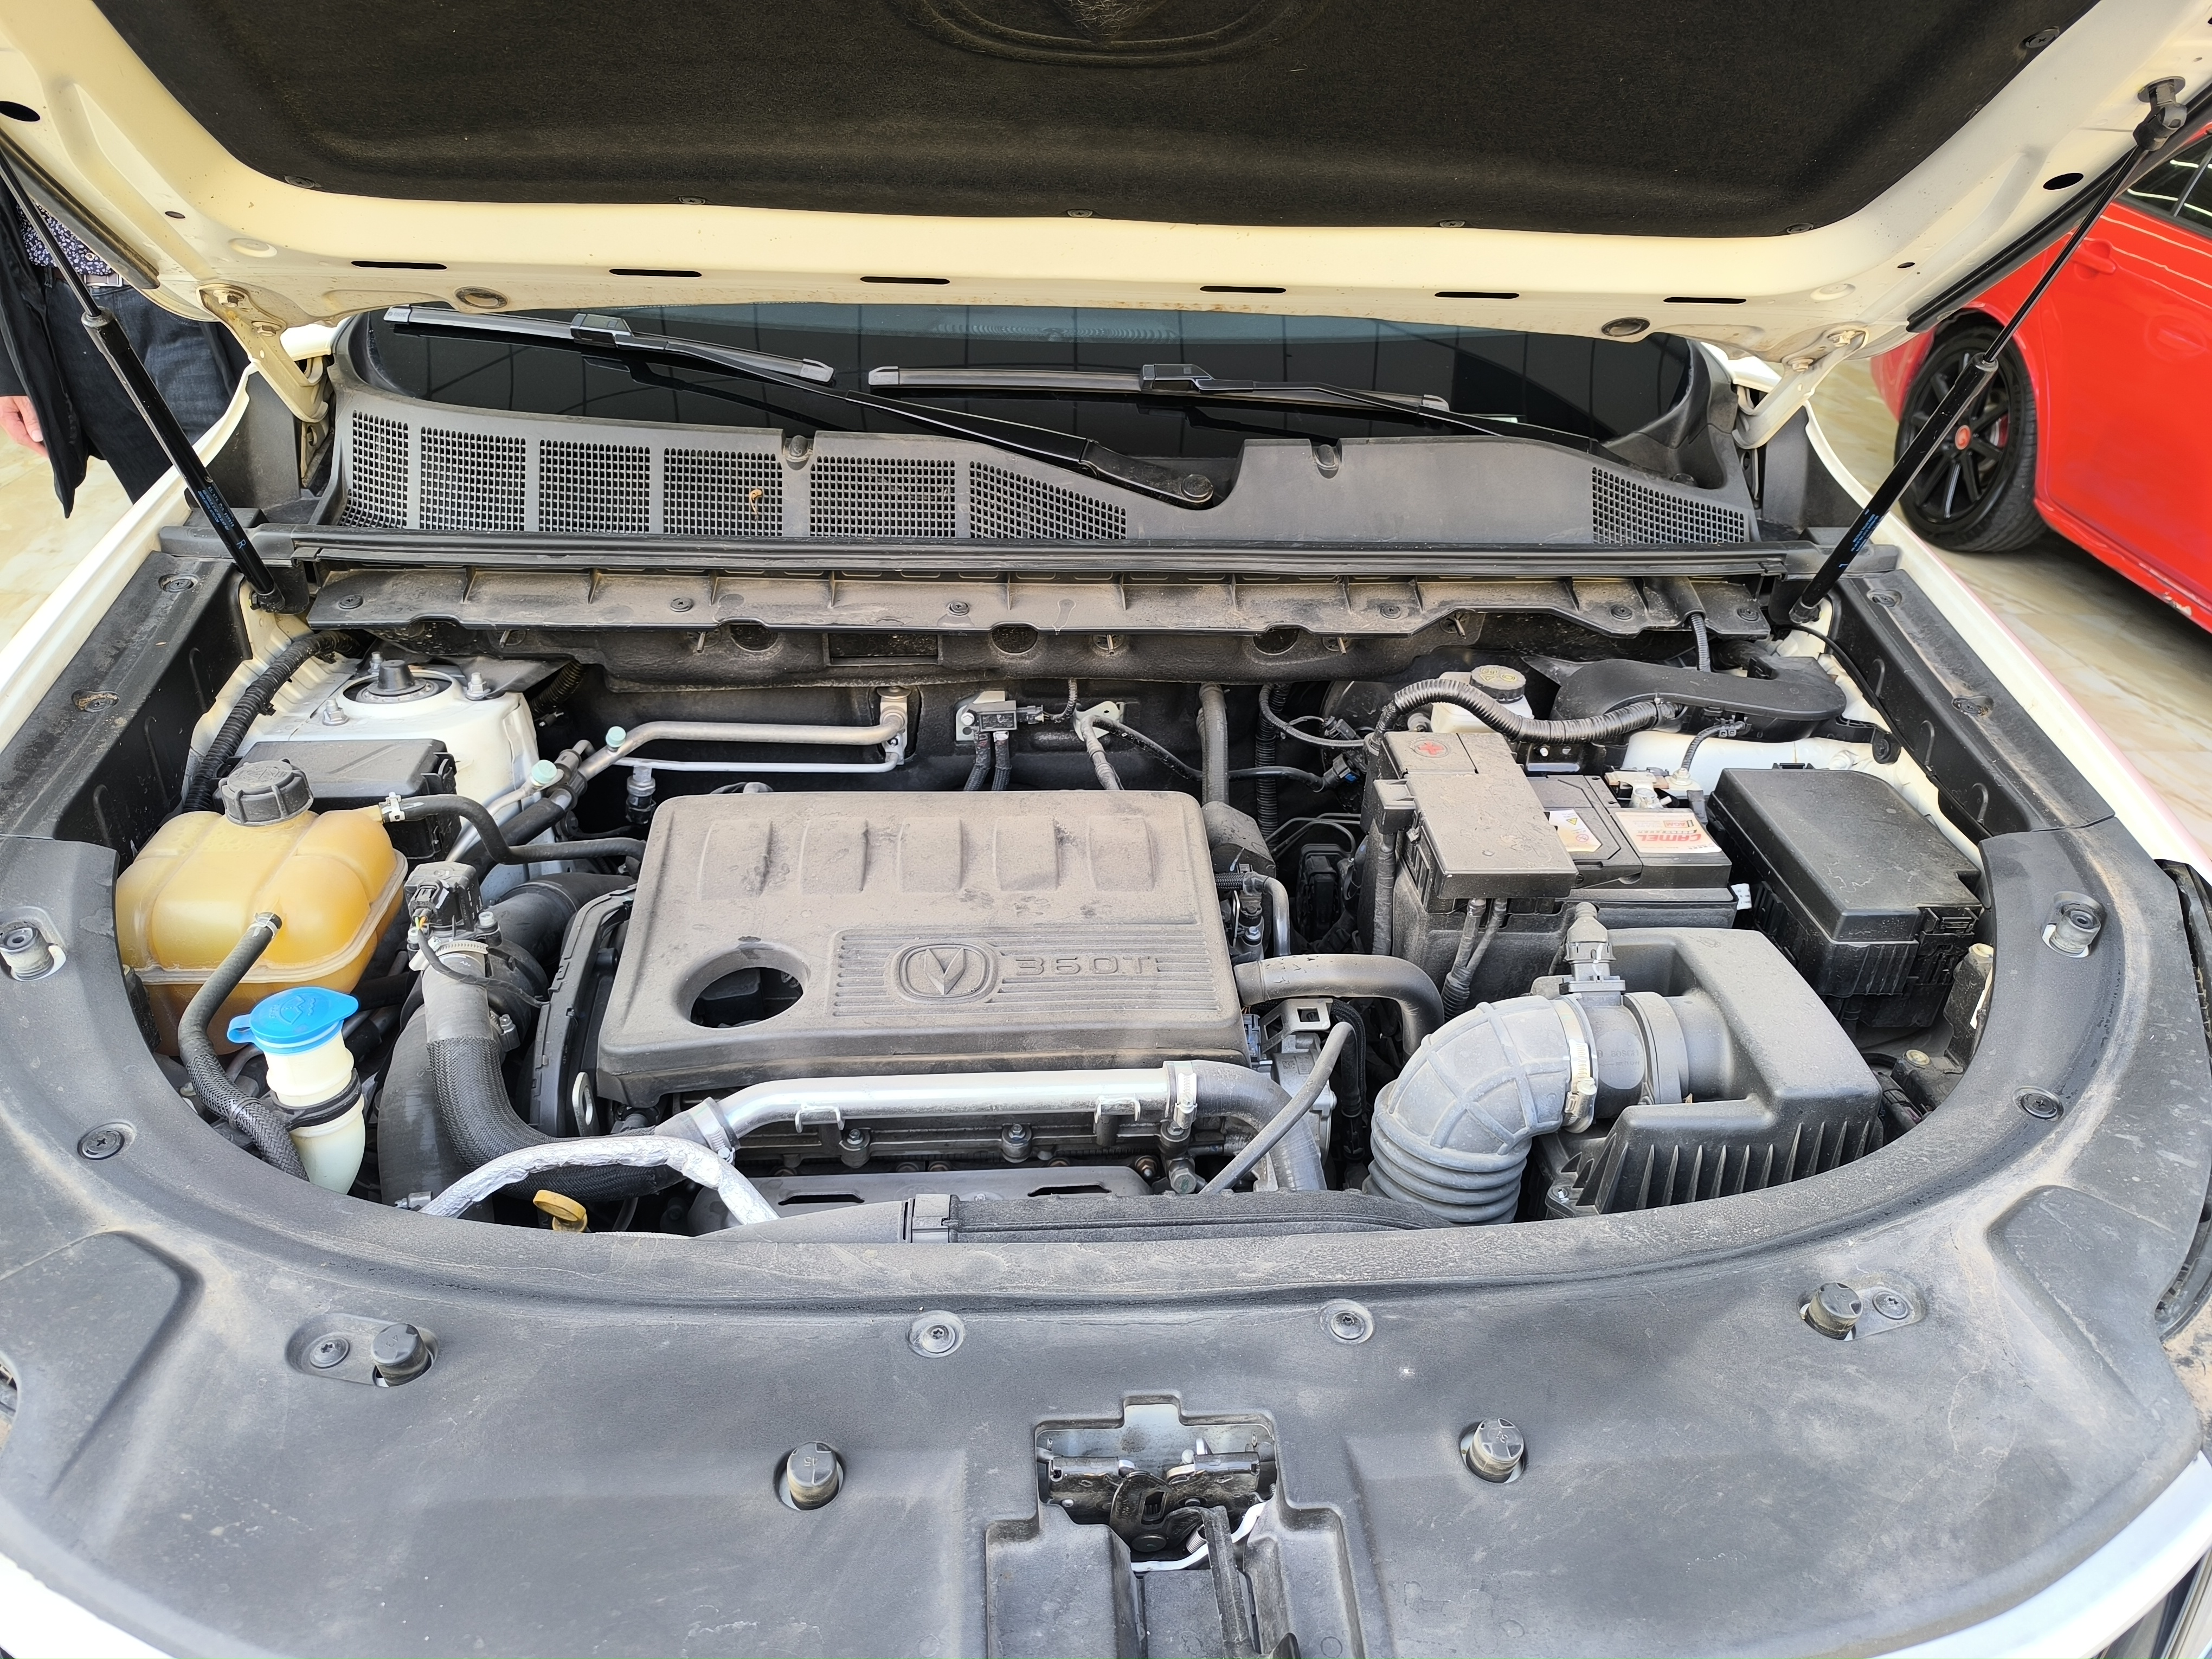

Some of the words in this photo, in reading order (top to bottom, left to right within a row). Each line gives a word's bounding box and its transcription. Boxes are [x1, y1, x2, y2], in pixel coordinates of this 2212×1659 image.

[236, 539, 246, 549] R
[1636, 834, 1701, 842] CAMEL
[1015, 956, 1150, 976] 360T
